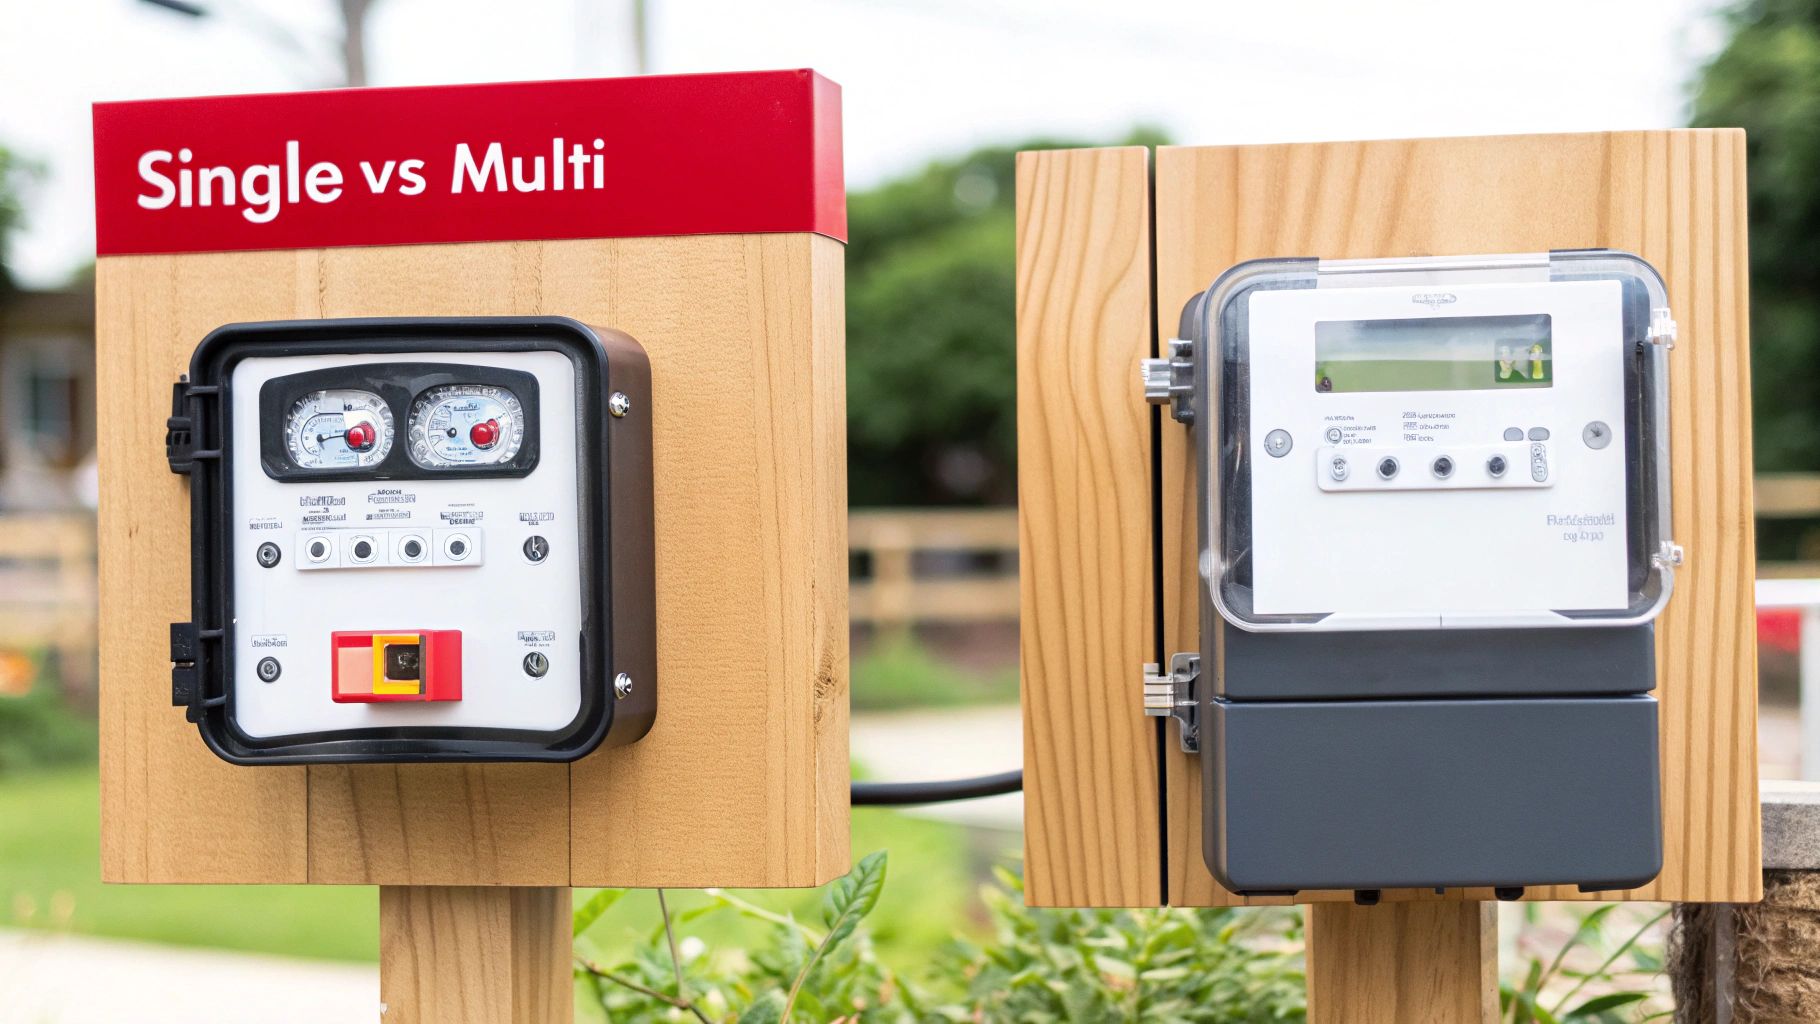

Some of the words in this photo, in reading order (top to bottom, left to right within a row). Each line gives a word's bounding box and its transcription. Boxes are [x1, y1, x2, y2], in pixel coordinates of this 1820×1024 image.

[137, 140, 343, 223] Single
[360, 158, 426, 195] vs
[451, 137, 605, 194] Multi
